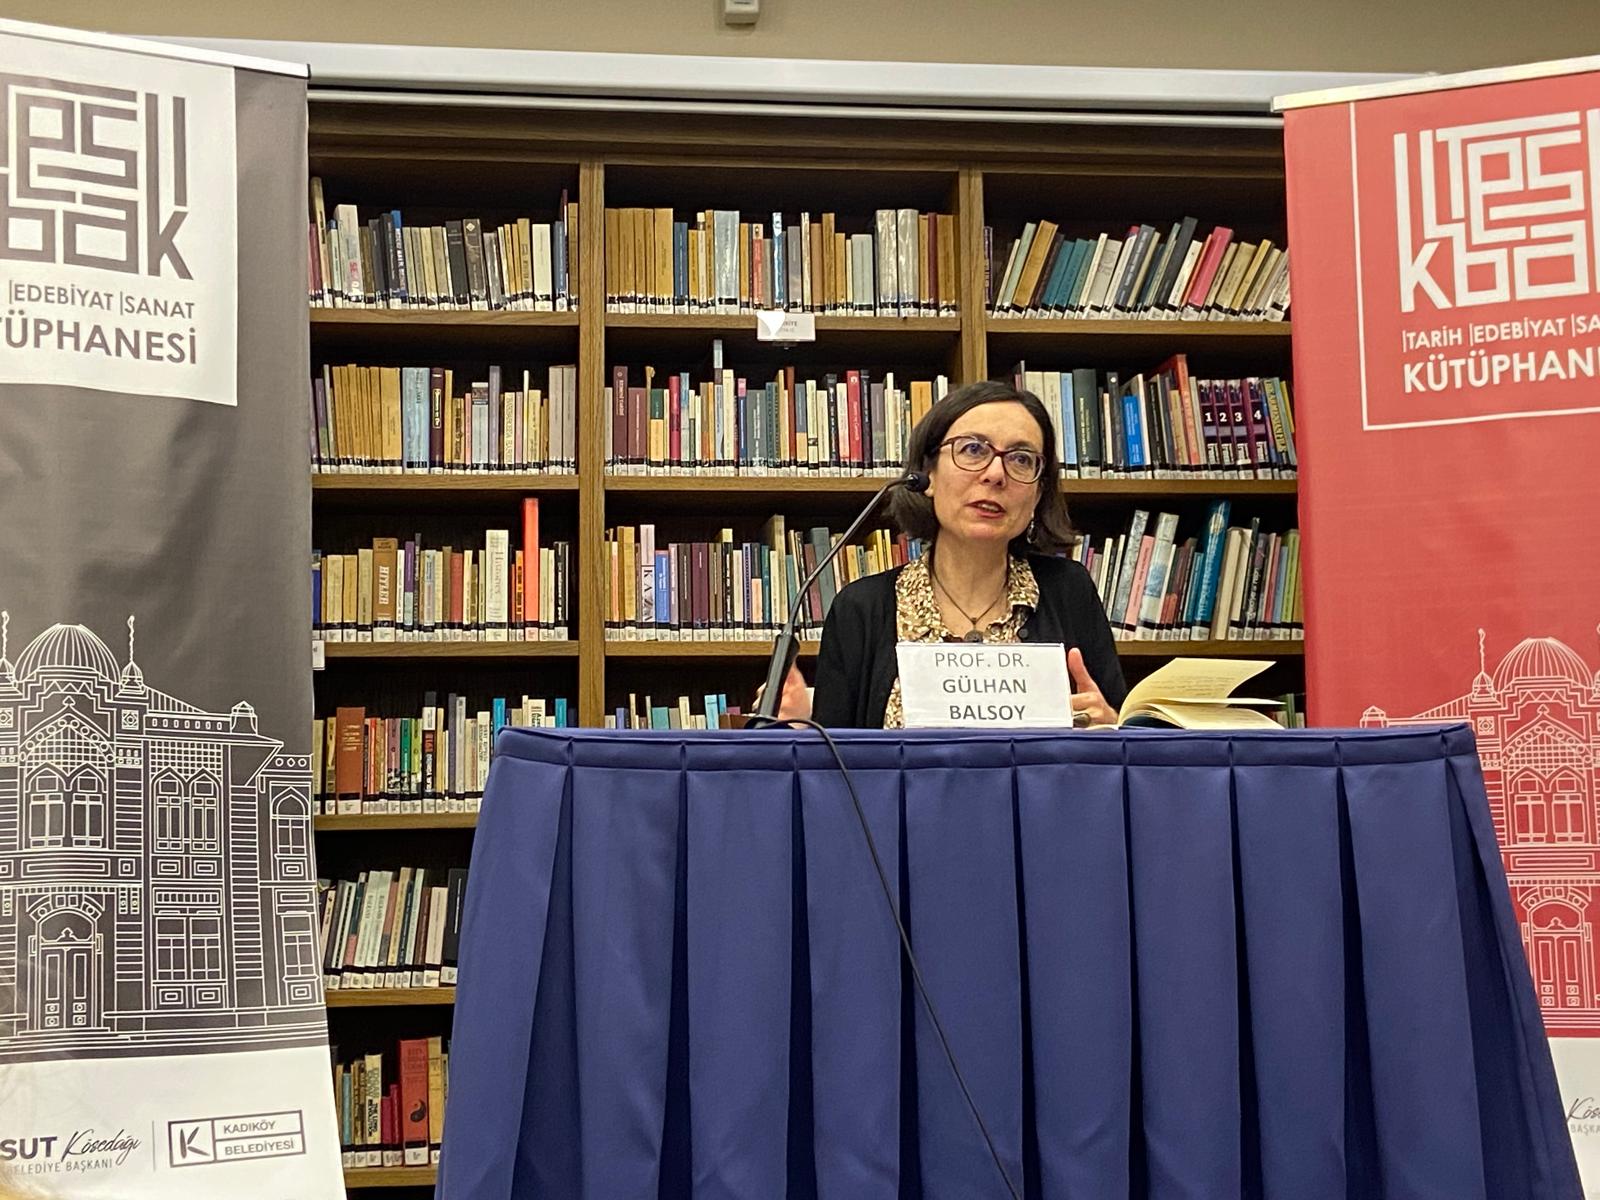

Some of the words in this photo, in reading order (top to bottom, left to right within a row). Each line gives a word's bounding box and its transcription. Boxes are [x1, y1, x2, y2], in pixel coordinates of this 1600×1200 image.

[14, 283, 113, 312] EDEBİYAT
[125, 296, 195, 320] SANAT
[0, 309, 197, 364] ÜPHANESİ
[1406, 325, 1462, 349] TARİH
[1474, 317, 1567, 344] EDEBİYAT
[1403, 346, 1600, 394] KÜTÜPHAN
[1205, 412, 1213, 422] 1
[1219, 412, 1228, 422] 2
[1234, 412, 1243, 422] 3
[1254, 410, 1262, 420] 4
[935, 653, 991, 667] PROF.
[998, 653, 1030, 667] DR.
[942, 675, 1027, 694] GÜLHAN
[949, 705, 1026, 720] BALSOY
[223, 1120, 276, 1134] KADIKÖY
[0, 1136, 58, 1161] SUT
[225, 1138, 295, 1156] BELEDİYESİ
[66, 1159, 112, 1174] BAŞKANI
